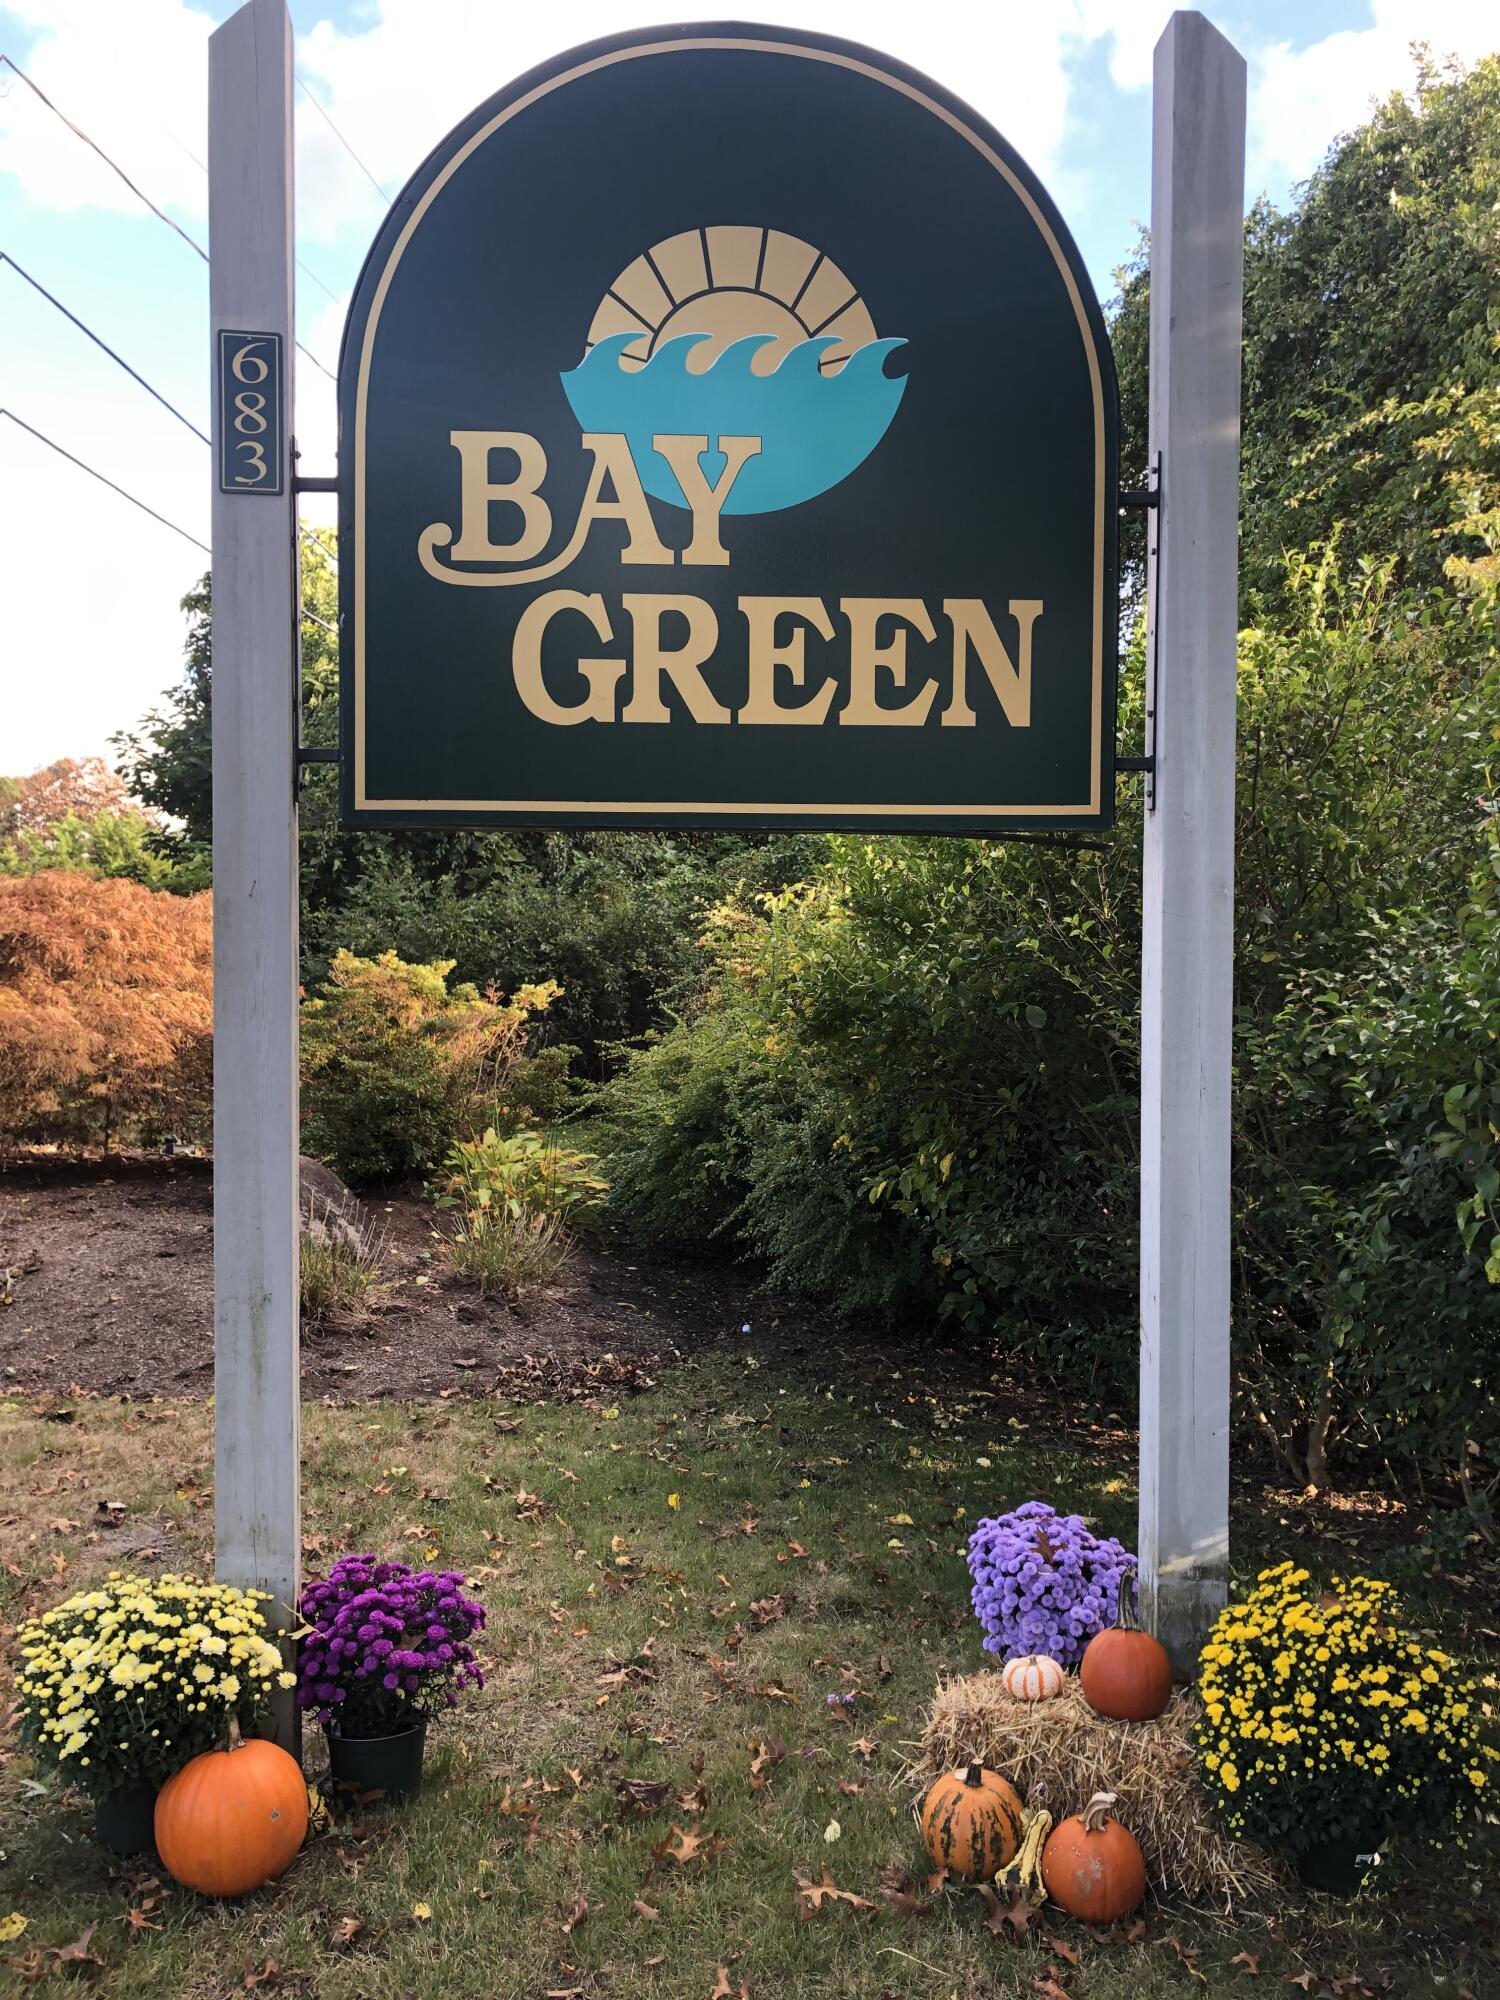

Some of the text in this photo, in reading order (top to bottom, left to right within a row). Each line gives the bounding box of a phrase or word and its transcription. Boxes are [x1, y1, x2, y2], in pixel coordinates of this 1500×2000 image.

[232, 342, 268, 483] 683
[417, 430, 762, 587] BAY
[511, 589, 1044, 727] GREEN
